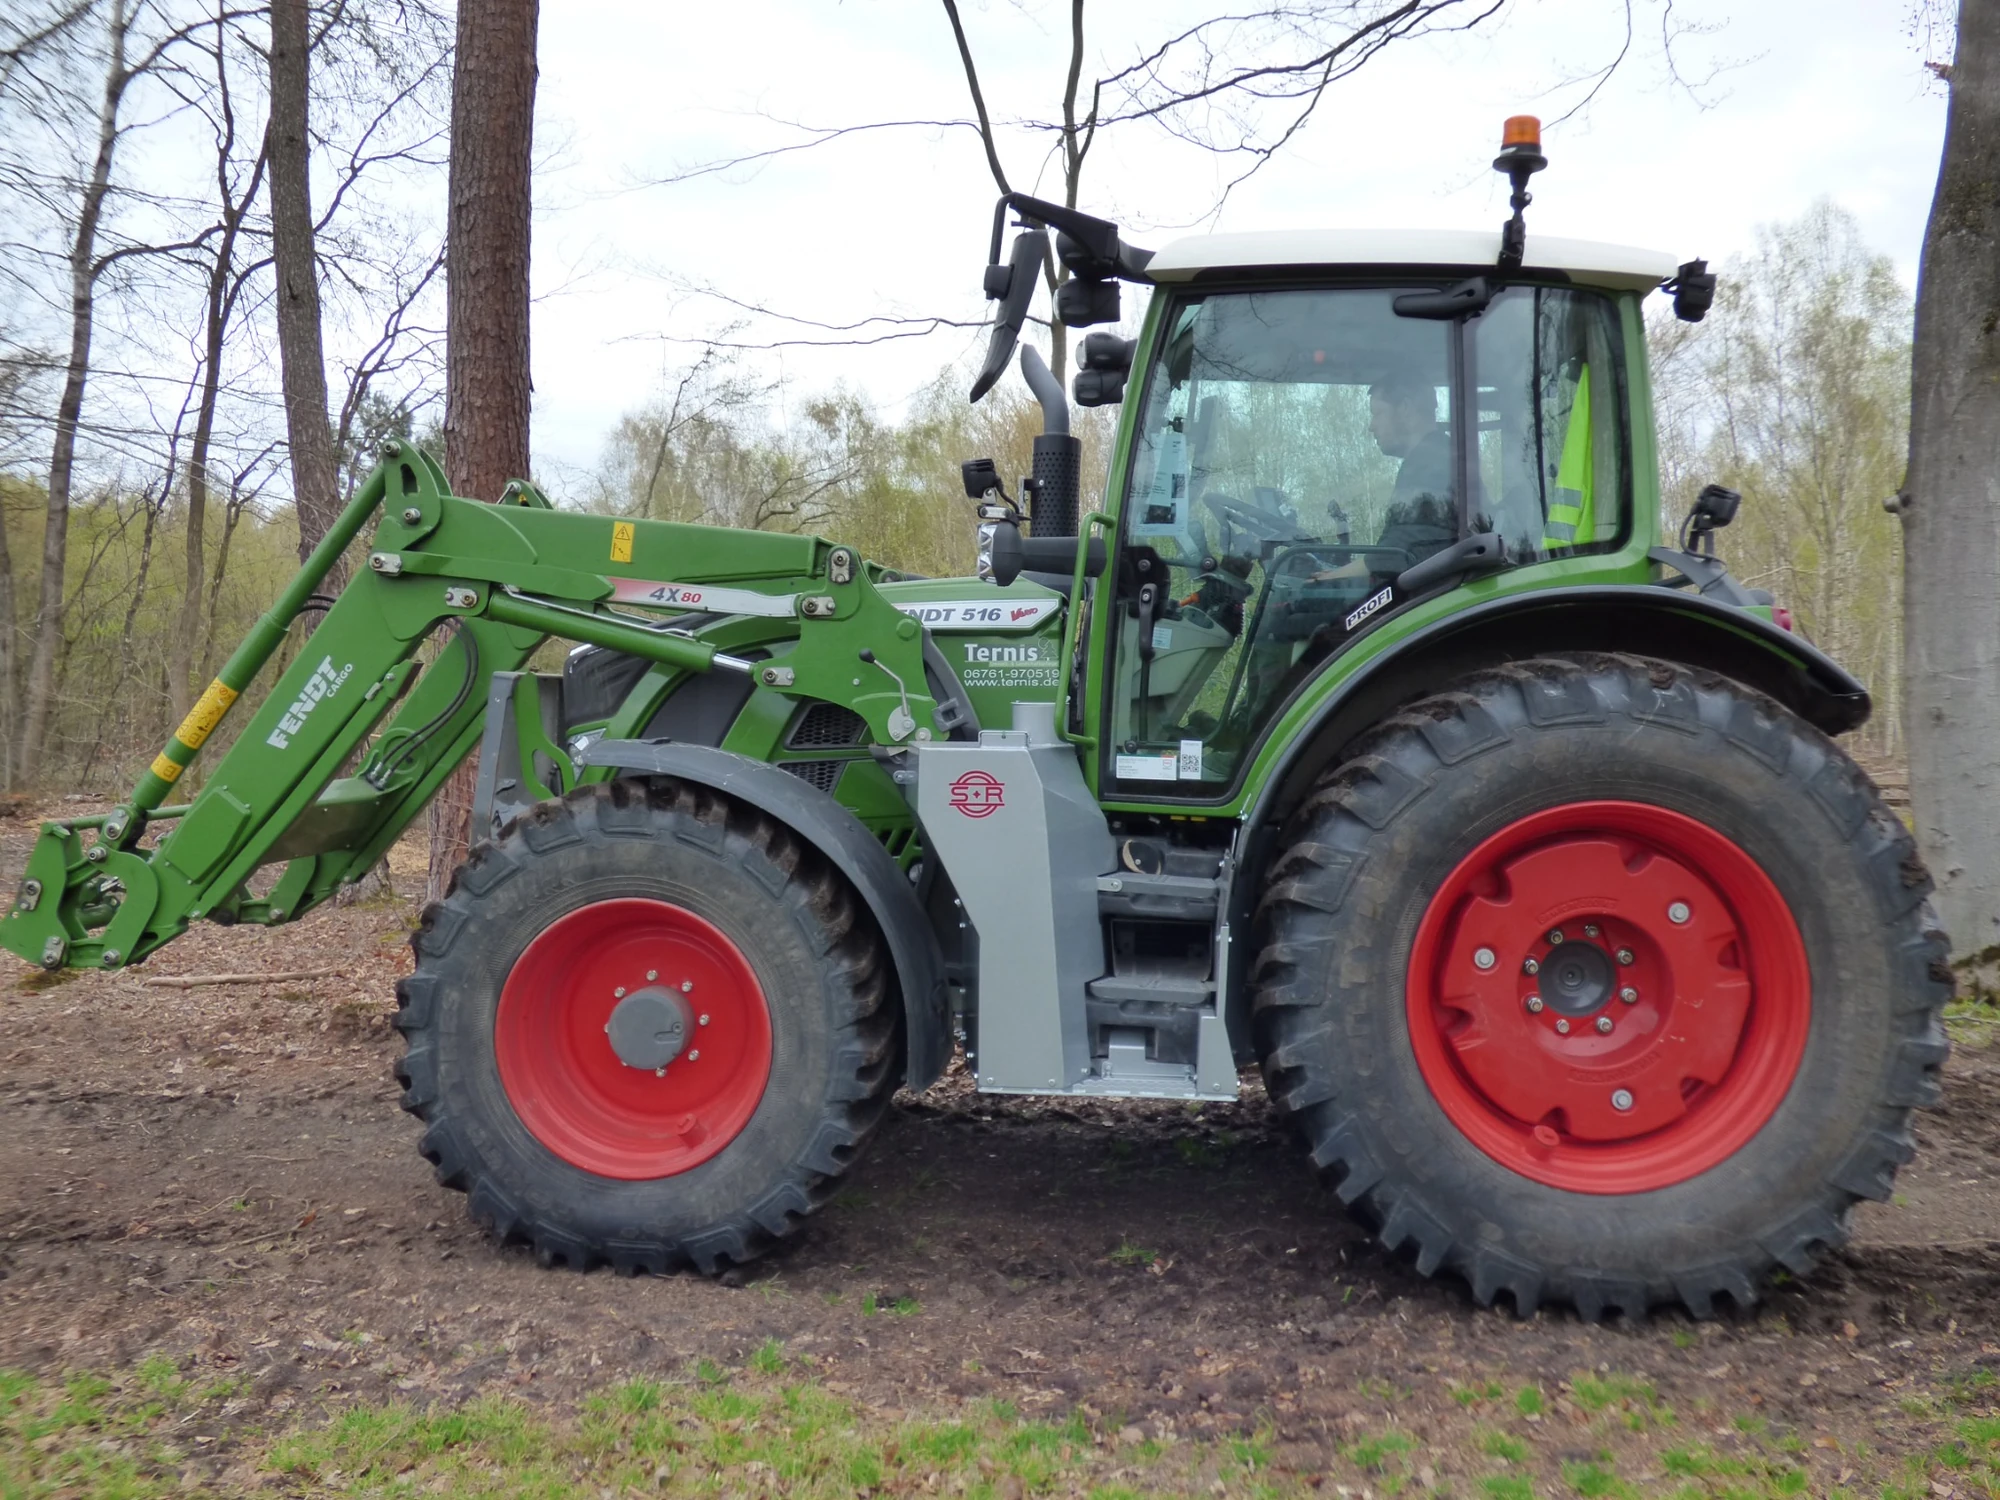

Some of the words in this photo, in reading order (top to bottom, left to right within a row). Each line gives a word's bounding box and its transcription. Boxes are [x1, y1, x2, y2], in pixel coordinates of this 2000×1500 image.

[900, 608, 956, 622] NDT
[961, 608, 1002, 622] 516
[1347, 589, 1391, 627] PROFI
[964, 643, 1038, 662] Ternis
[326, 663, 353, 698] CARGO
[964, 669, 1060, 679] 06761-970519
[964, 678, 1060, 687] www.ternis.de
[266, 655, 337, 750] FENDT
